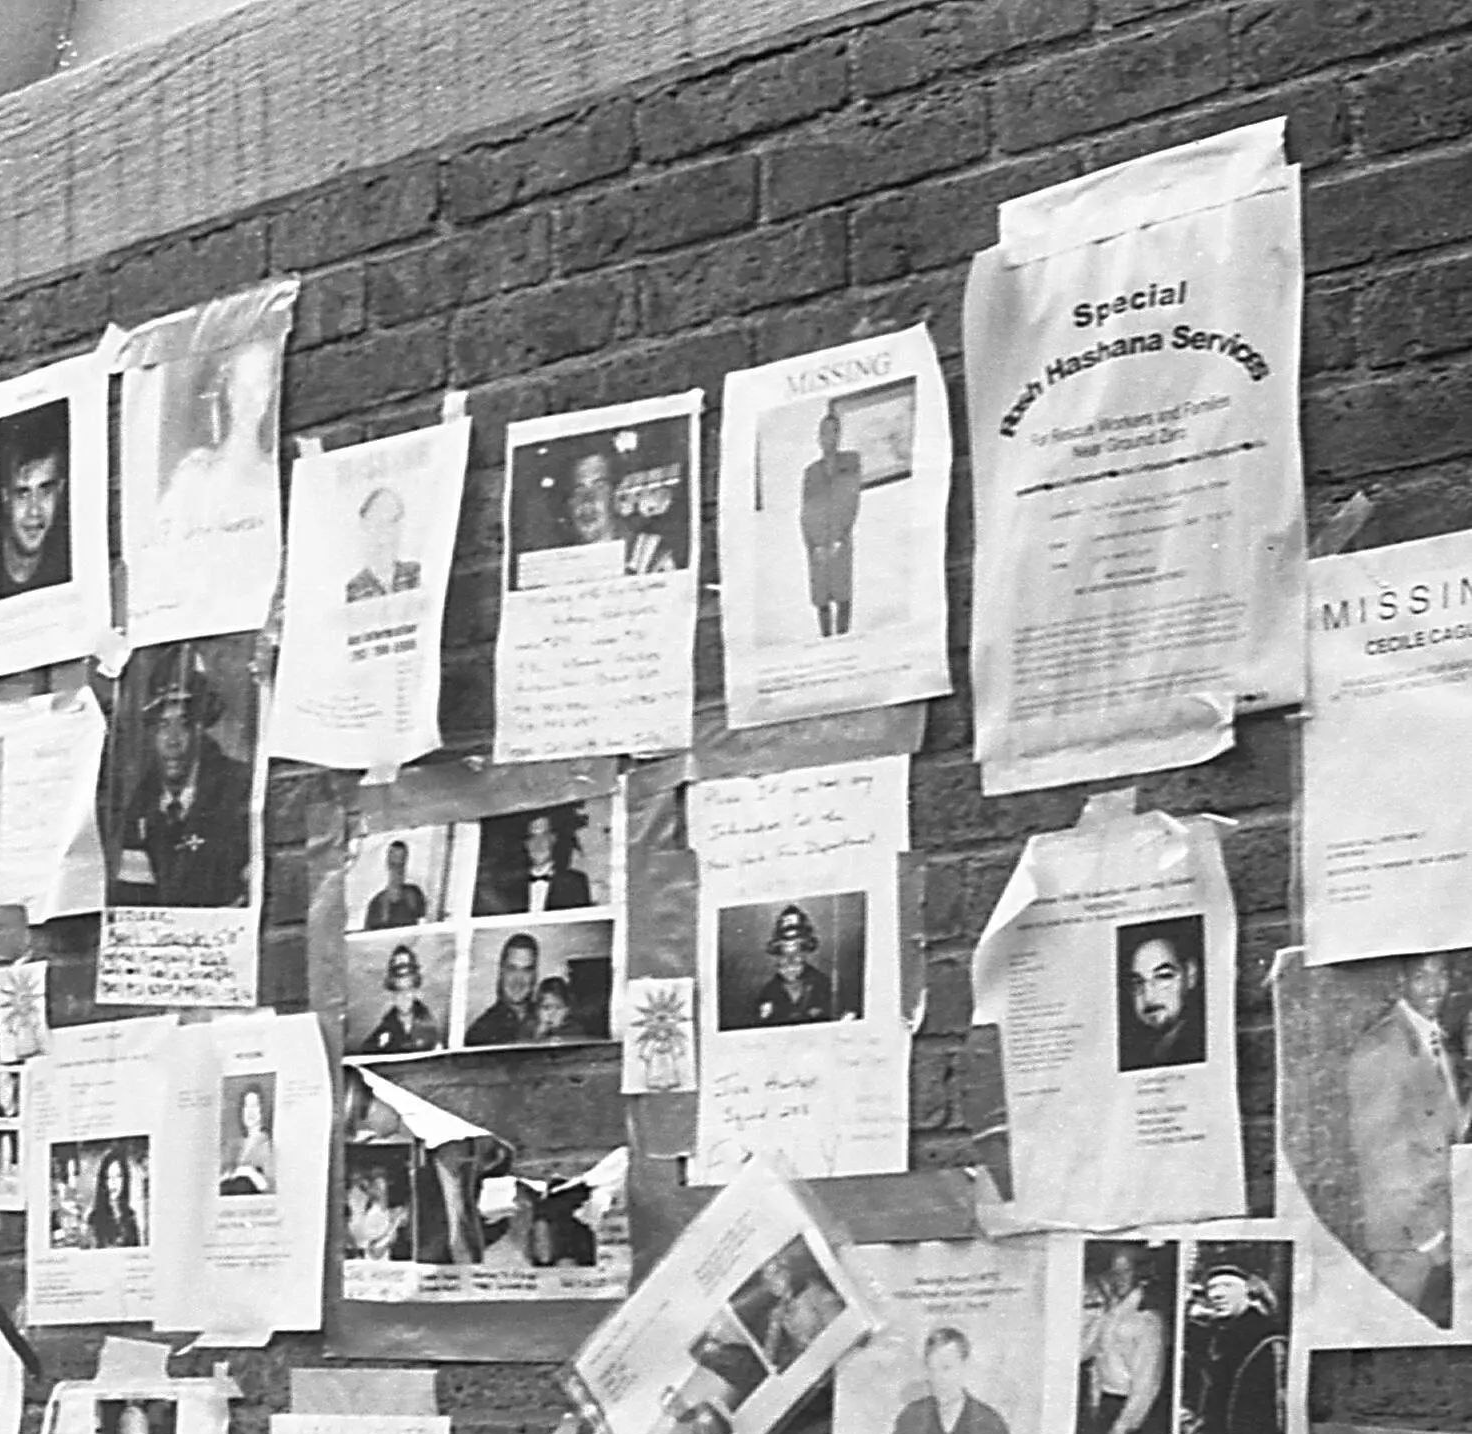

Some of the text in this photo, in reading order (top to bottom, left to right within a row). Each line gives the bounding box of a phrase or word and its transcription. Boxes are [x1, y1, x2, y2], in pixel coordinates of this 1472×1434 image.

[1072, 281, 1188, 328] Special
[1045, 331, 1163, 385] Hashana
[1170, 324, 1270, 382] Services
[1365, 630, 1426, 656] CECILE
